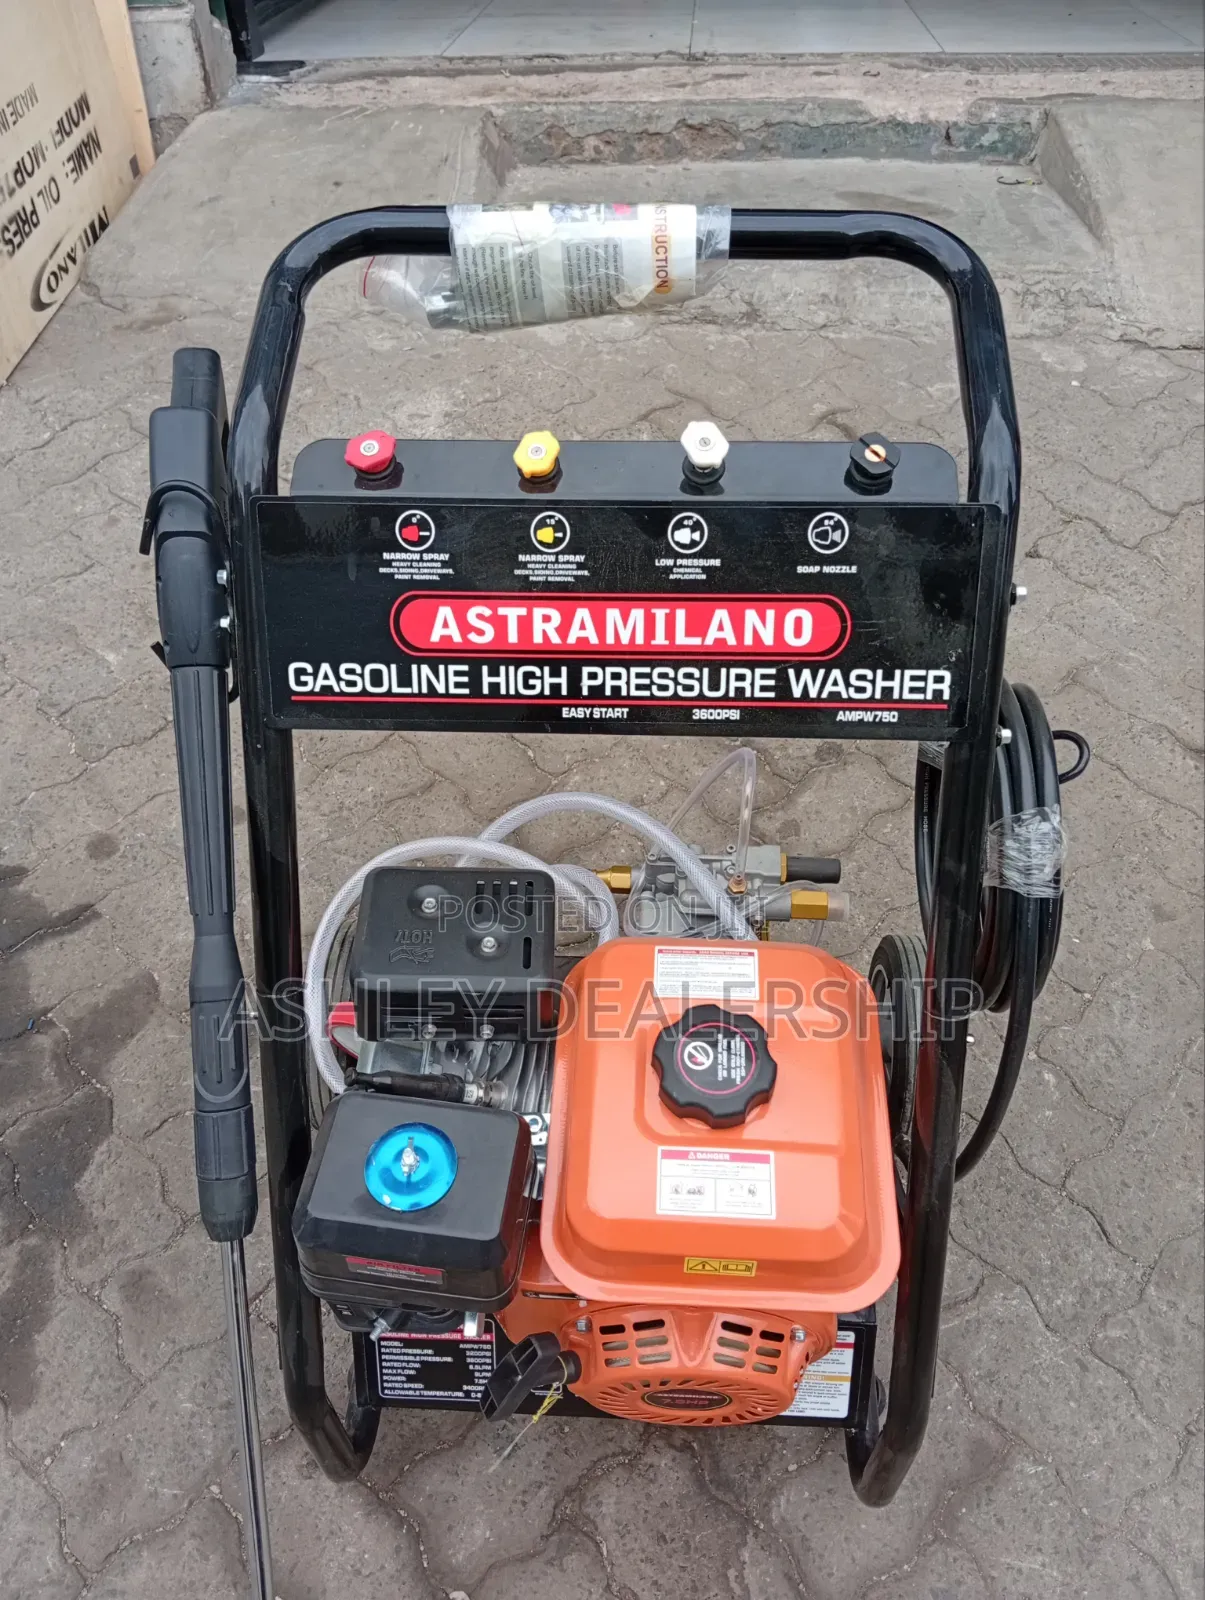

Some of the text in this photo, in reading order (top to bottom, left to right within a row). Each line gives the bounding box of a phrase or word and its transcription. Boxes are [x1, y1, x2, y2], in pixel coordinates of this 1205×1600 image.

[37, 175, 61, 214] OIL
[45, 204, 110, 294] MILANO
[382, 552, 450, 561] NARROW SPRAY
[518, 554, 586, 563] NARROW SPRAY
[655, 559, 721, 567] LOW PRESSURE
[796, 565, 858, 574] SOAP NOZZLE
[429, 605, 813, 648] ASTRAMILANO
[287, 661, 951, 701] GASOLINE HIGH PRESSURE WASHER
[562, 707, 630, 719] EASY START
[692, 708, 741, 720] 3600PSI
[836, 710, 898, 723] AMPW750
[696, 1151, 731, 1161] DANGER
